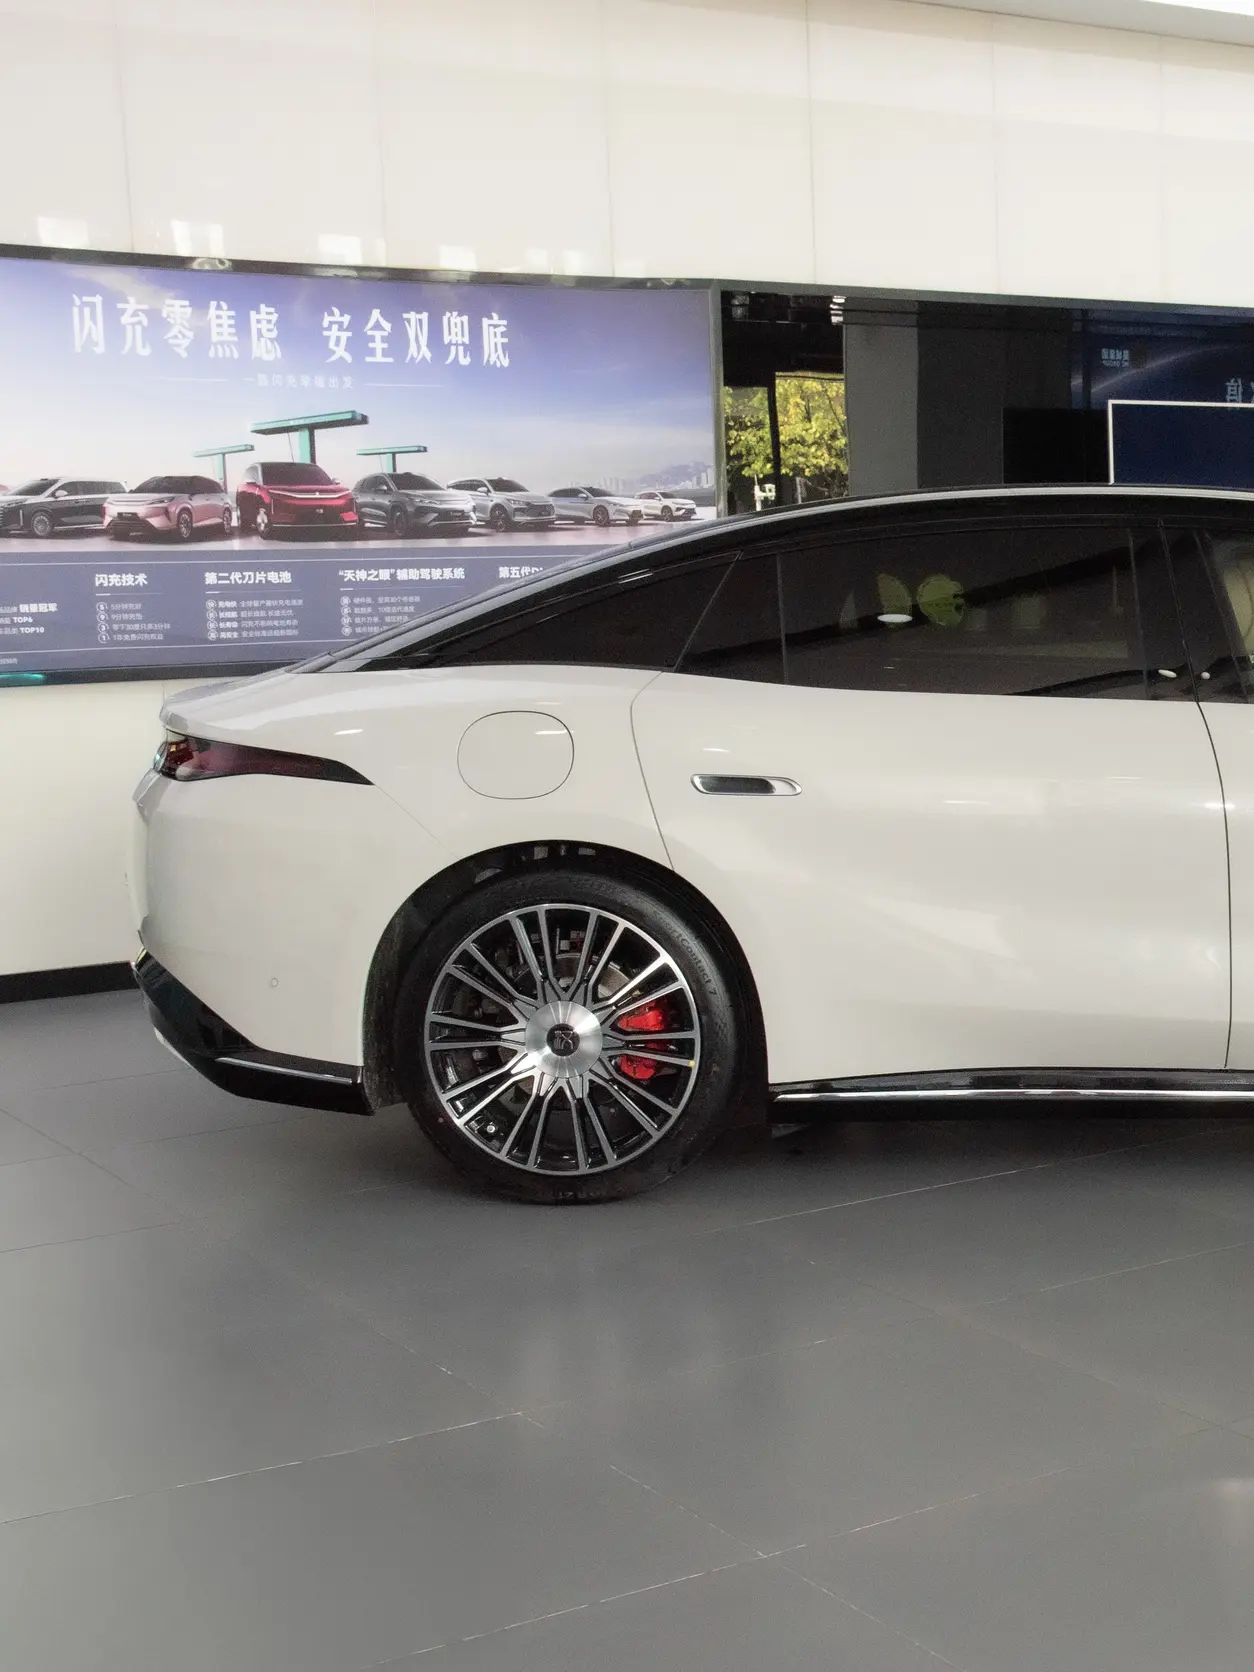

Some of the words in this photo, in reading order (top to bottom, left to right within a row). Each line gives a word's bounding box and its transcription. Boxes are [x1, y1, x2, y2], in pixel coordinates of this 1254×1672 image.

[72, 294, 282, 361] 闪充零焦虑
[322, 307, 510, 367] 安全双兜底
[95, 573, 148, 587] 闪充技术
[204, 571, 292, 585] 第二代刀片电池
[12, 616, 34, 624] TOP6
[708, 986, 718, 996] 7
